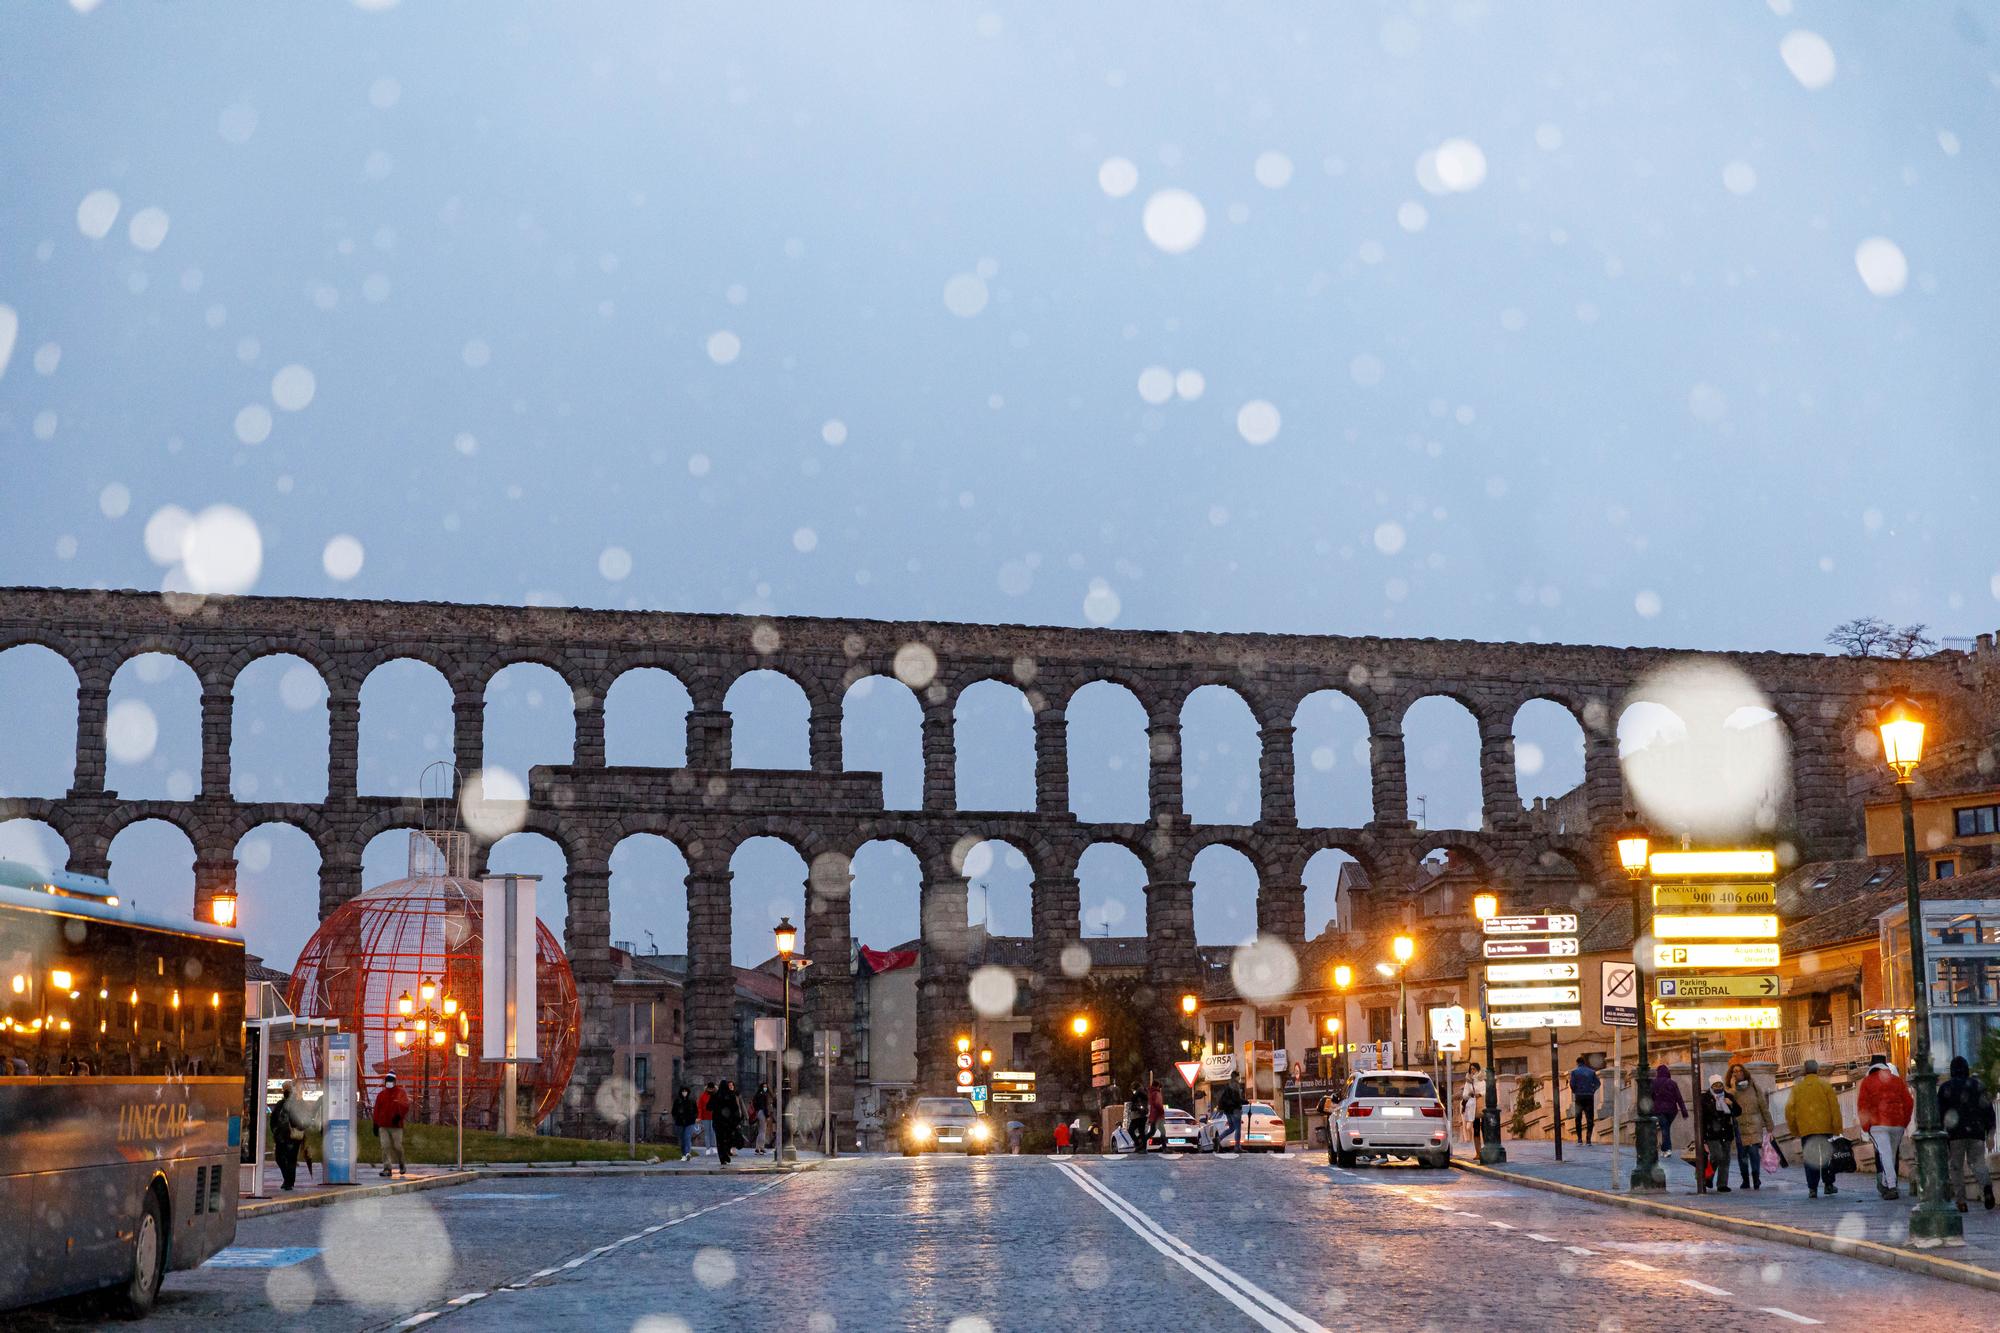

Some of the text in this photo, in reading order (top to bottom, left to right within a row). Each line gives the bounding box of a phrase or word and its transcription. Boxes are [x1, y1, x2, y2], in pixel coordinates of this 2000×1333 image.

[1693, 891, 1769, 903] 900 406 600
[1680, 986, 1730, 996] CATEDRAL
[117, 1103, 187, 1142] LINECAR
